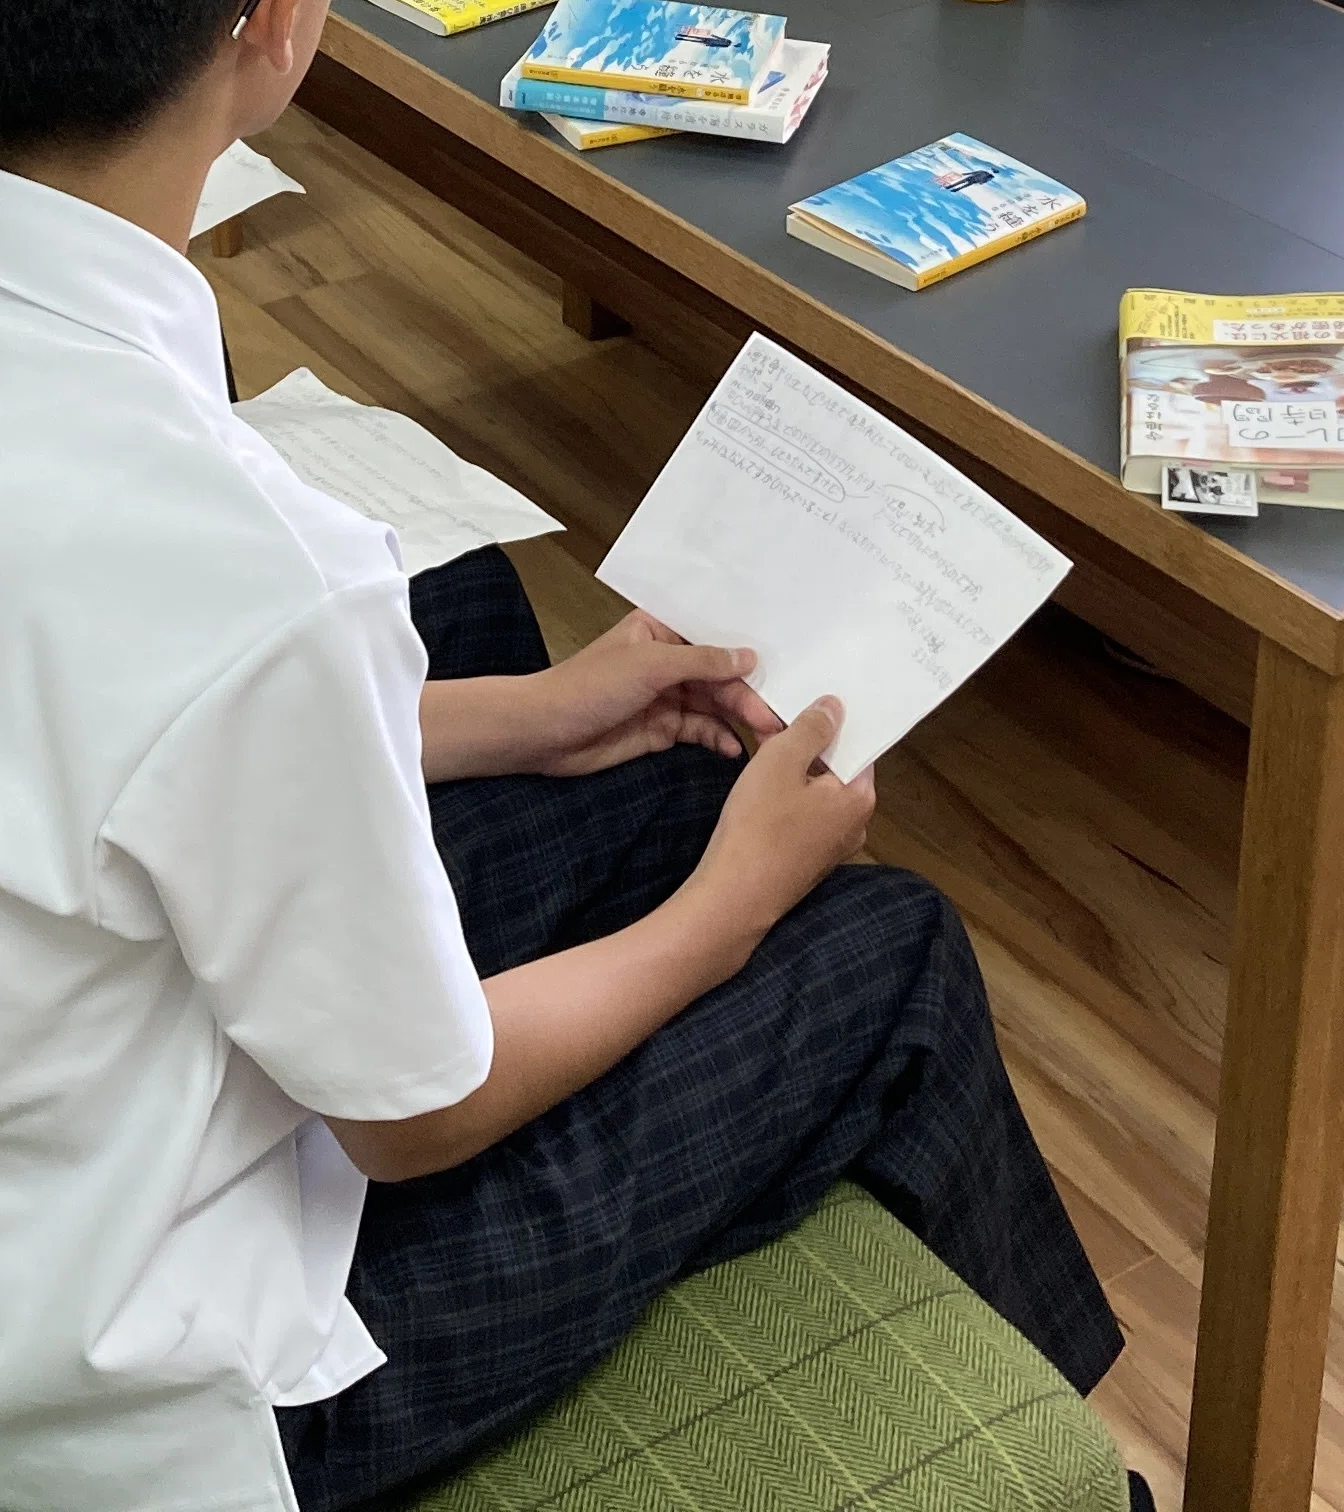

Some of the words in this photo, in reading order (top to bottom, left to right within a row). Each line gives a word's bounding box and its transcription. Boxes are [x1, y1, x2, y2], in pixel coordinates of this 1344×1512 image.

[631, 64, 730, 84] 水を縫う
[984, 195, 1062, 232] 水を縫う
